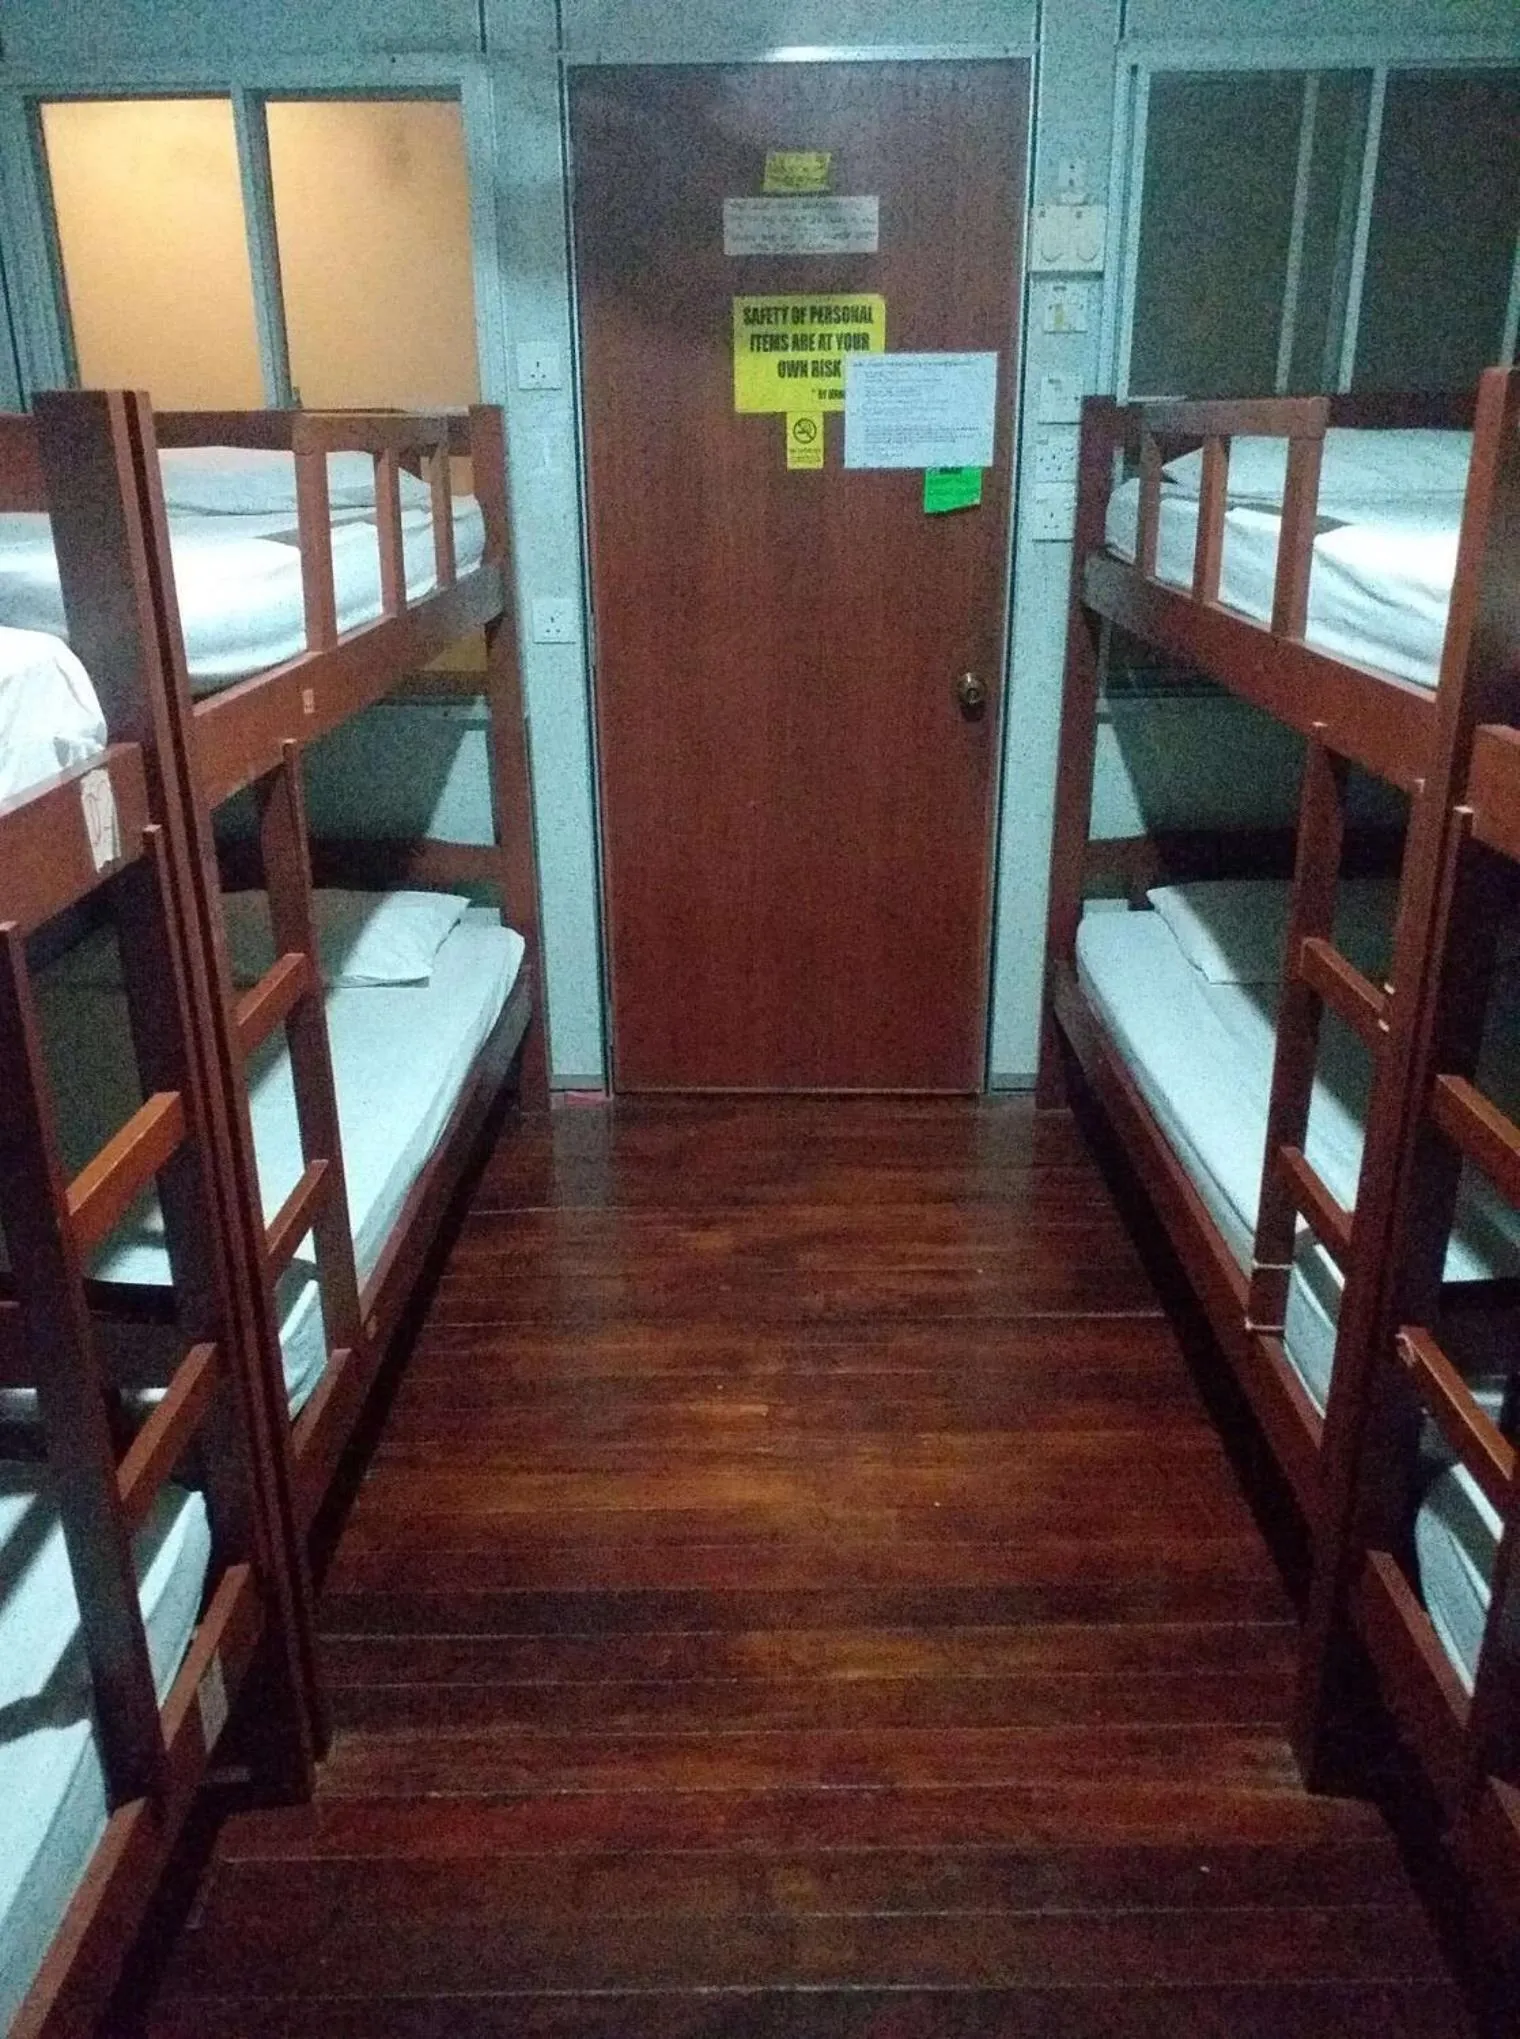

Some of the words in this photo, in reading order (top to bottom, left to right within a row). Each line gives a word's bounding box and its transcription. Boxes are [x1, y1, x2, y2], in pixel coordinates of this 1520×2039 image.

[743, 306, 789, 325] SAFETY
[791, 306, 807, 324] OF
[810, 305, 873, 324] PERSONAL
[750, 334, 789, 352] ITEMS
[791, 334, 816, 351] ARE
[818, 333, 833, 351] AT
[836, 333, 870, 351] YOUR
[777, 360, 808, 378] OWN
[811, 359, 841, 378] RISK
